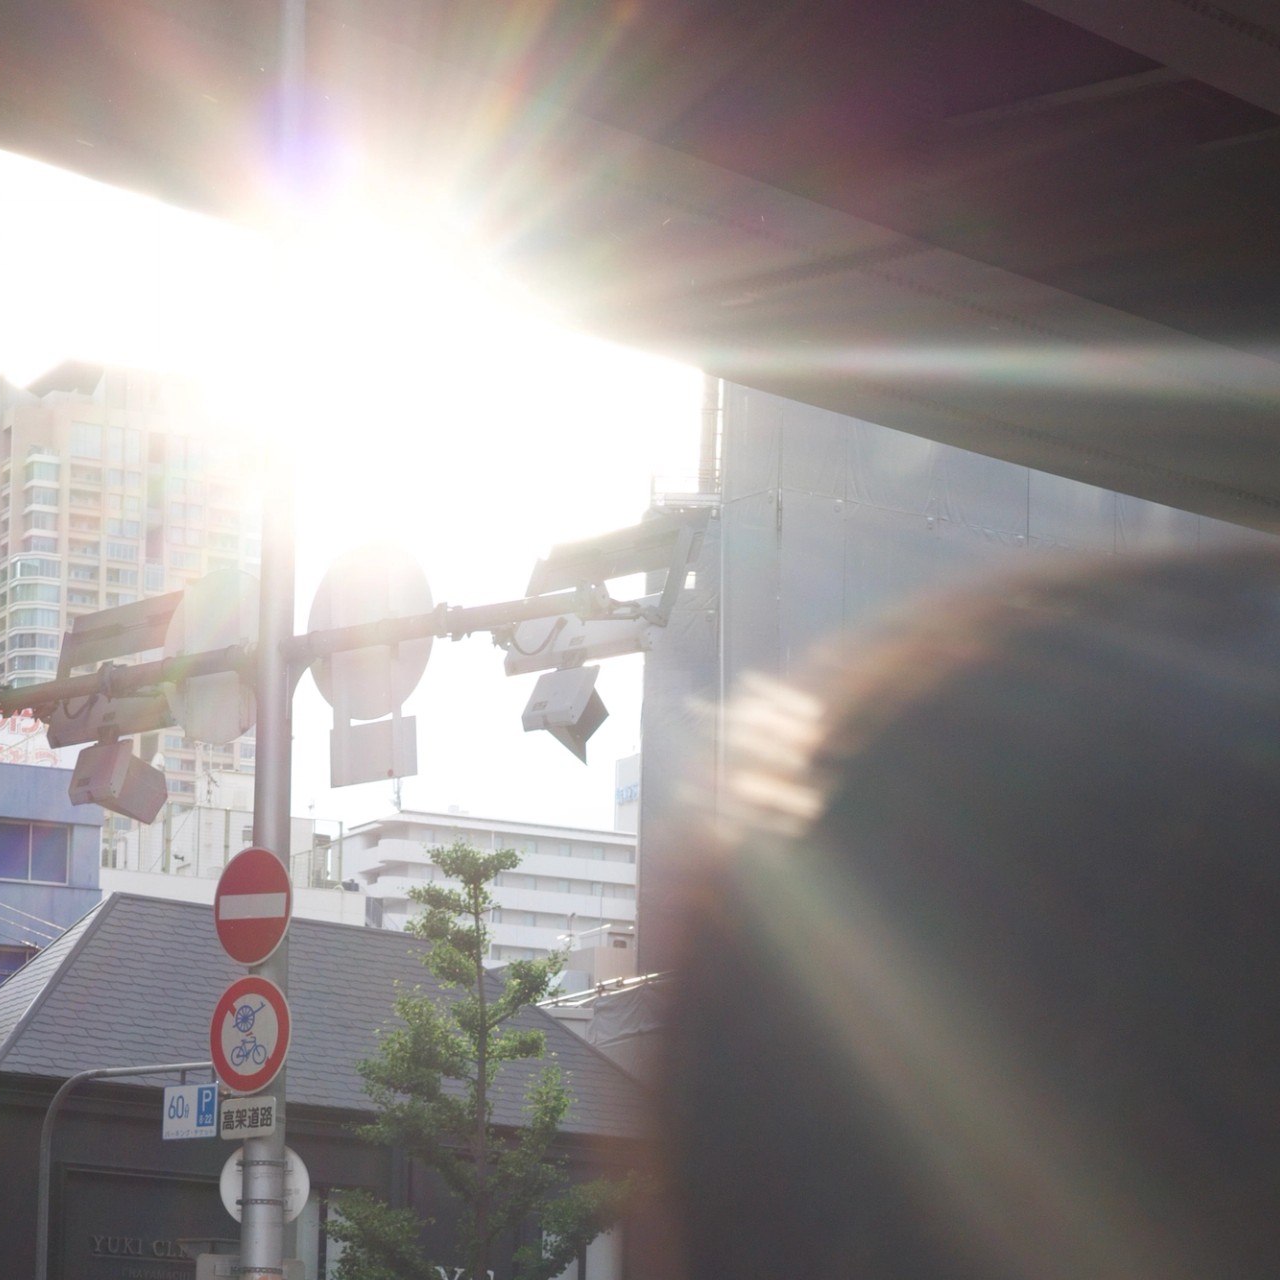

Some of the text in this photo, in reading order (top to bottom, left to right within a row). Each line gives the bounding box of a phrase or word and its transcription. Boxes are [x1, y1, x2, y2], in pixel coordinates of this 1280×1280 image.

[202, 1090, 212, 1112] P
[222, 1106, 273, 1131] 高架道路
[93, 1235, 143, 1255] YUKI
